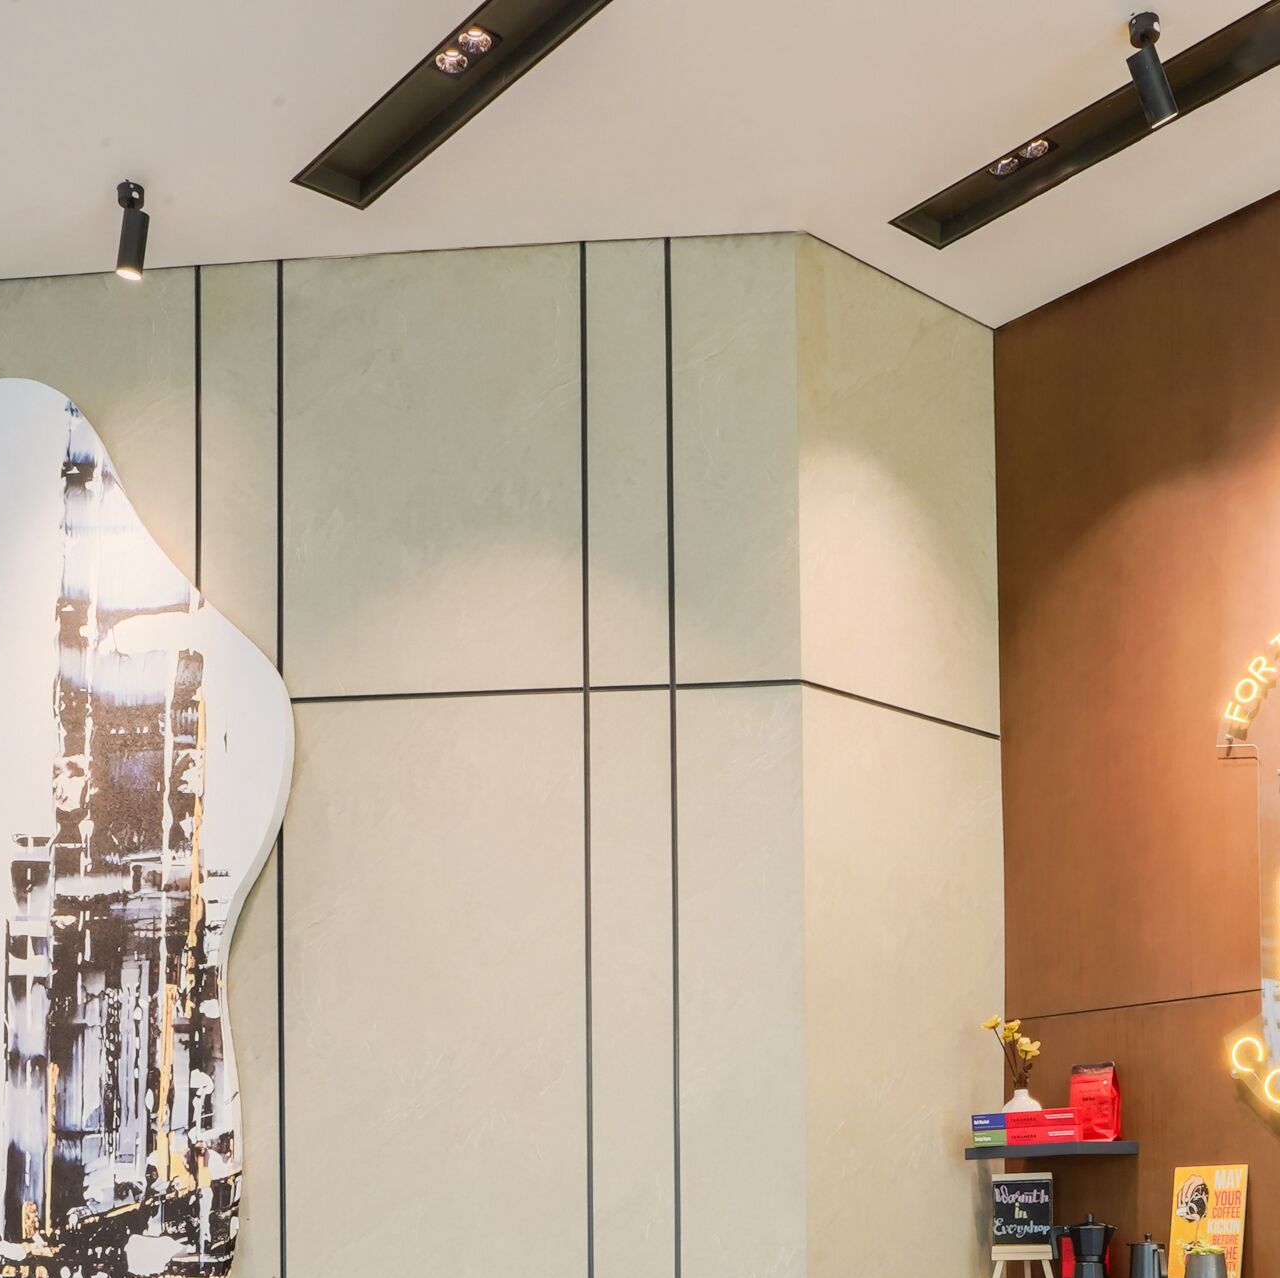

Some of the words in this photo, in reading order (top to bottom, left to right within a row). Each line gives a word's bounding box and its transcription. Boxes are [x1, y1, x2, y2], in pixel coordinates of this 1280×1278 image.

[1224, 655, 1278, 723] FOR
[1214, 1168, 1243, 1189] MAY
[994, 1185, 1049, 1204] Warmth
[1214, 1190, 1242, 1206] YOUR
[1014, 1202, 1028, 1219] in
[1212, 1207, 1240, 1219] COFFEE
[1212, 1234, 1239, 1246] BEFORE
